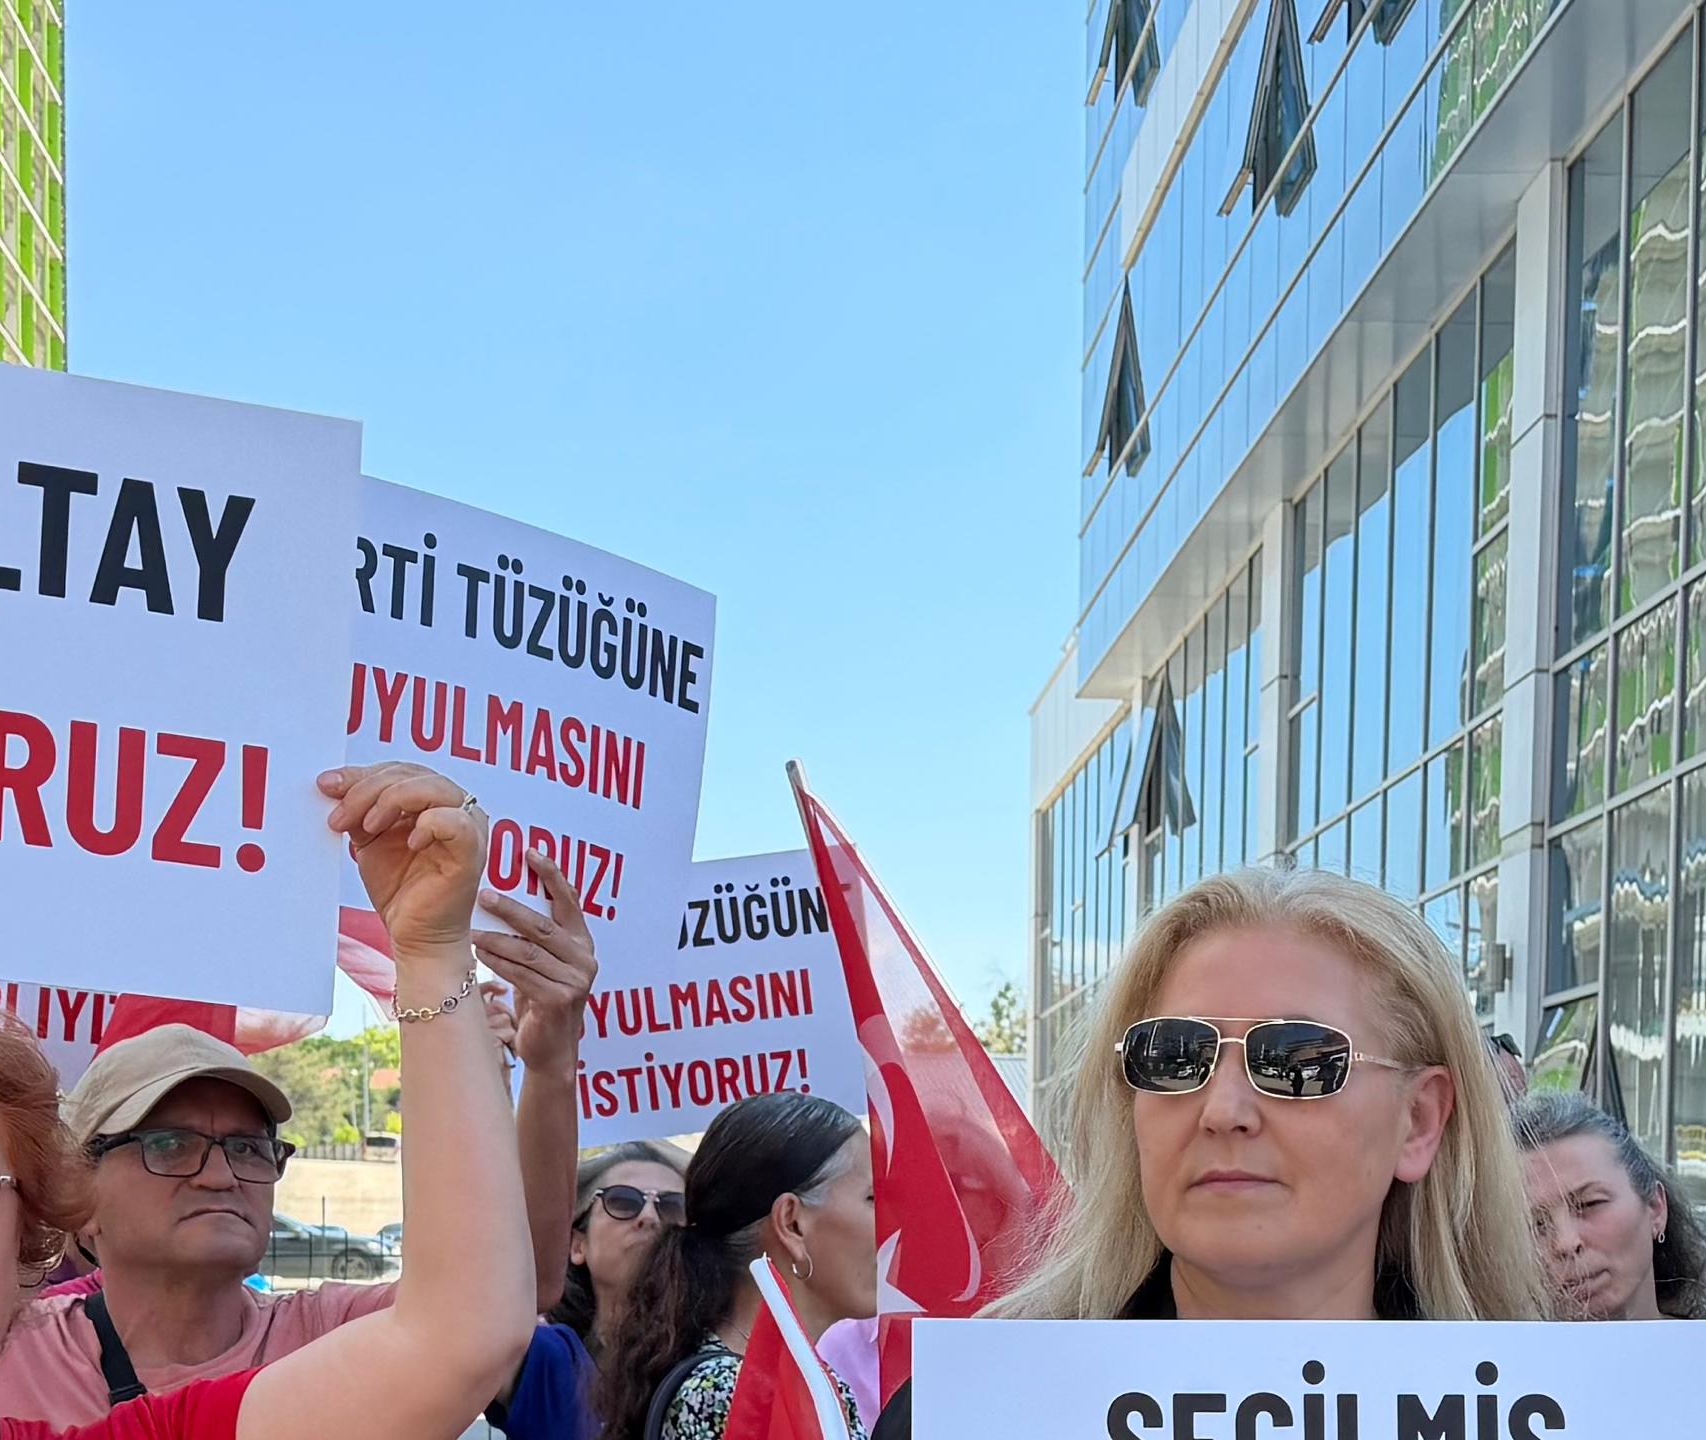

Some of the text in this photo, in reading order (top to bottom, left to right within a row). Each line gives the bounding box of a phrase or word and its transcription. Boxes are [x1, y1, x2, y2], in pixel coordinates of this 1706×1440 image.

[456, 553, 705, 714] TÜZÜĞÜNE
[677, 875, 830, 950] ZÜĞÜN
[578, 967, 814, 1042] YULMASINI
[577, 1048, 811, 1121] İSTİYORUZ!
